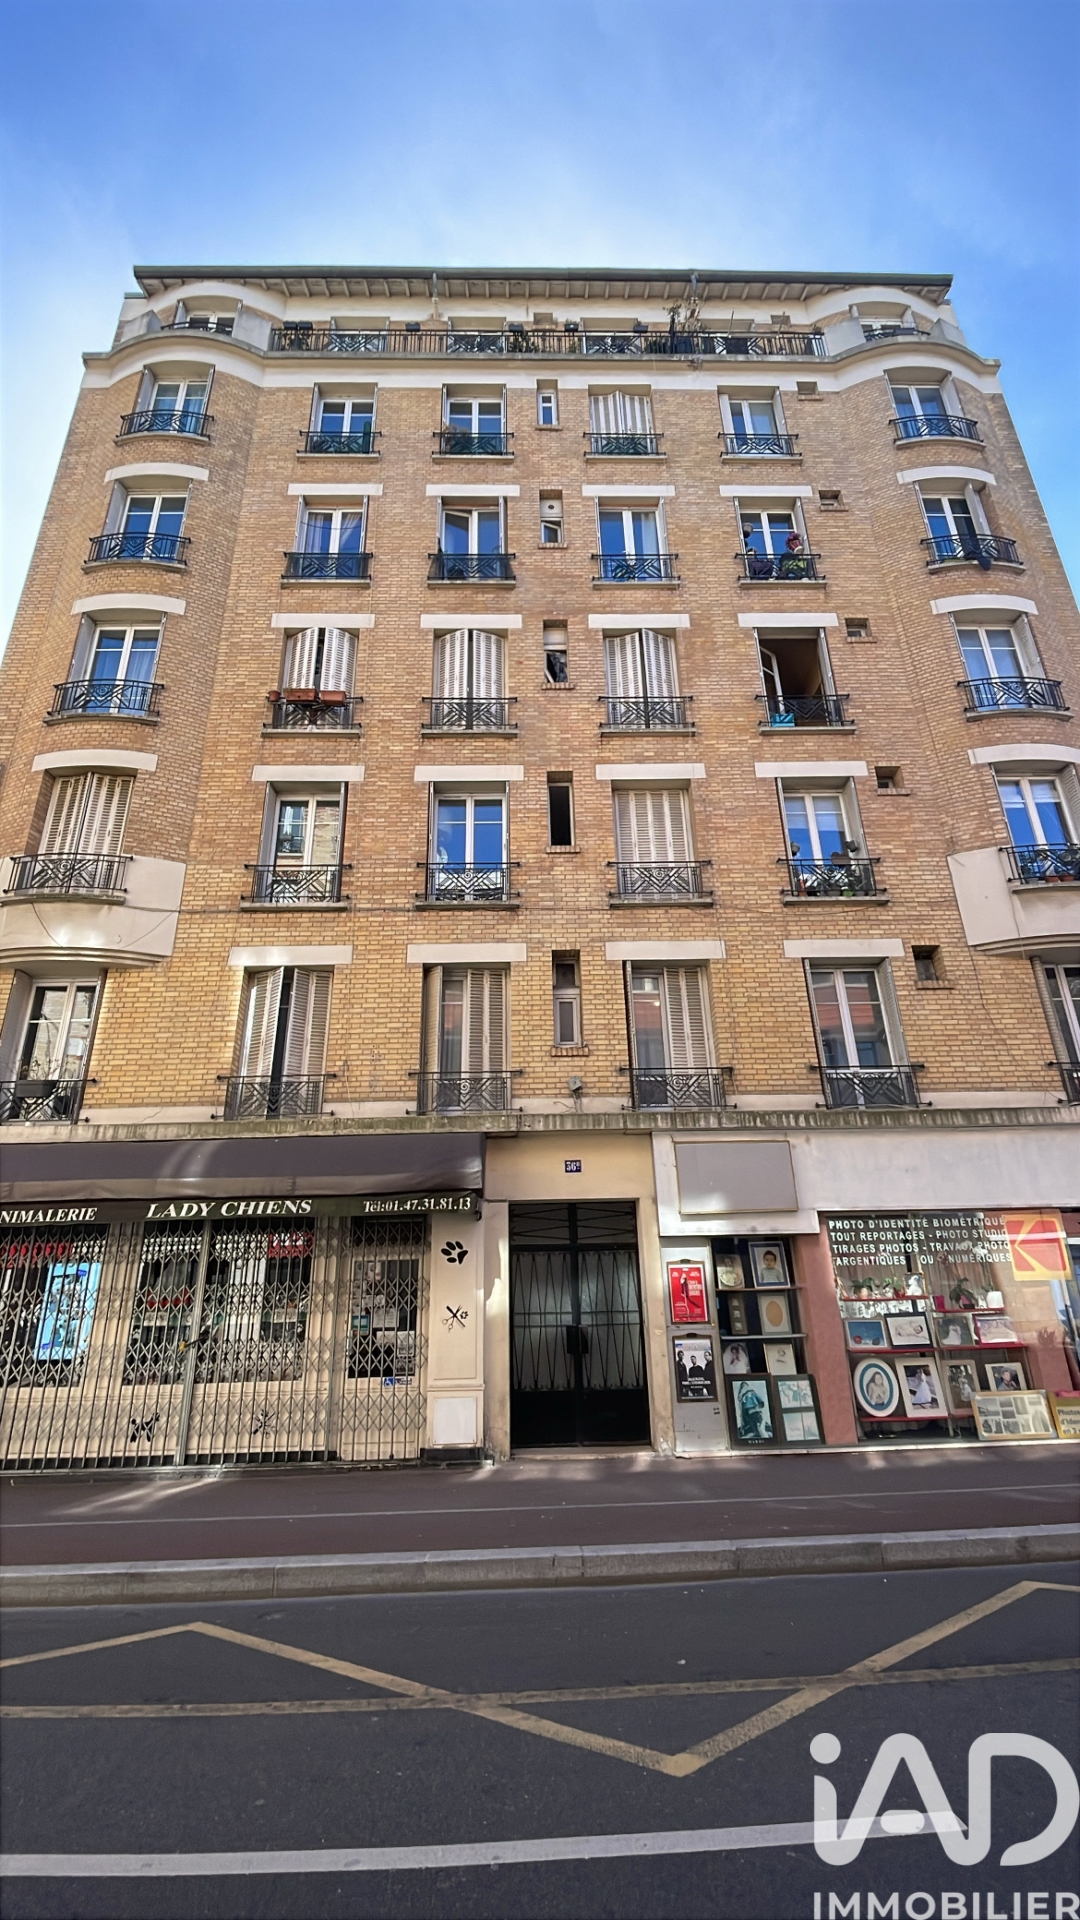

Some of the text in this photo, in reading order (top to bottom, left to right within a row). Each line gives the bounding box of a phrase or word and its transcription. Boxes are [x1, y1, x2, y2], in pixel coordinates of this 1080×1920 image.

[146, 1200, 312, 1218] LADY CHIENS
[363, 1197, 471, 1212] Tél:01.47.31.81.13
[0, 1207, 98, 1223] NIMALERIE
[829, 1220, 864, 1230] PHOTO
[868, 1217, 929, 1229] D'IDENTITÉ
[830, 1232, 856, 1241] TOUT
[860, 1231, 925, 1241] REPORTAGES
[935, 1230, 968, 1239] PHOTO
[972, 1229, 1007, 1239] STUDIO
[832, 1244, 876, 1254] TIRAGES
[880, 1243, 919, 1253] PHOTOS
[929, 1242, 973, 1252] TRAVAUX
[977, 1241, 1010, 1250] PHOTO
[836, 1253, 1012, 1266] ARGENTIQUES OU NUMÉRIQUES
